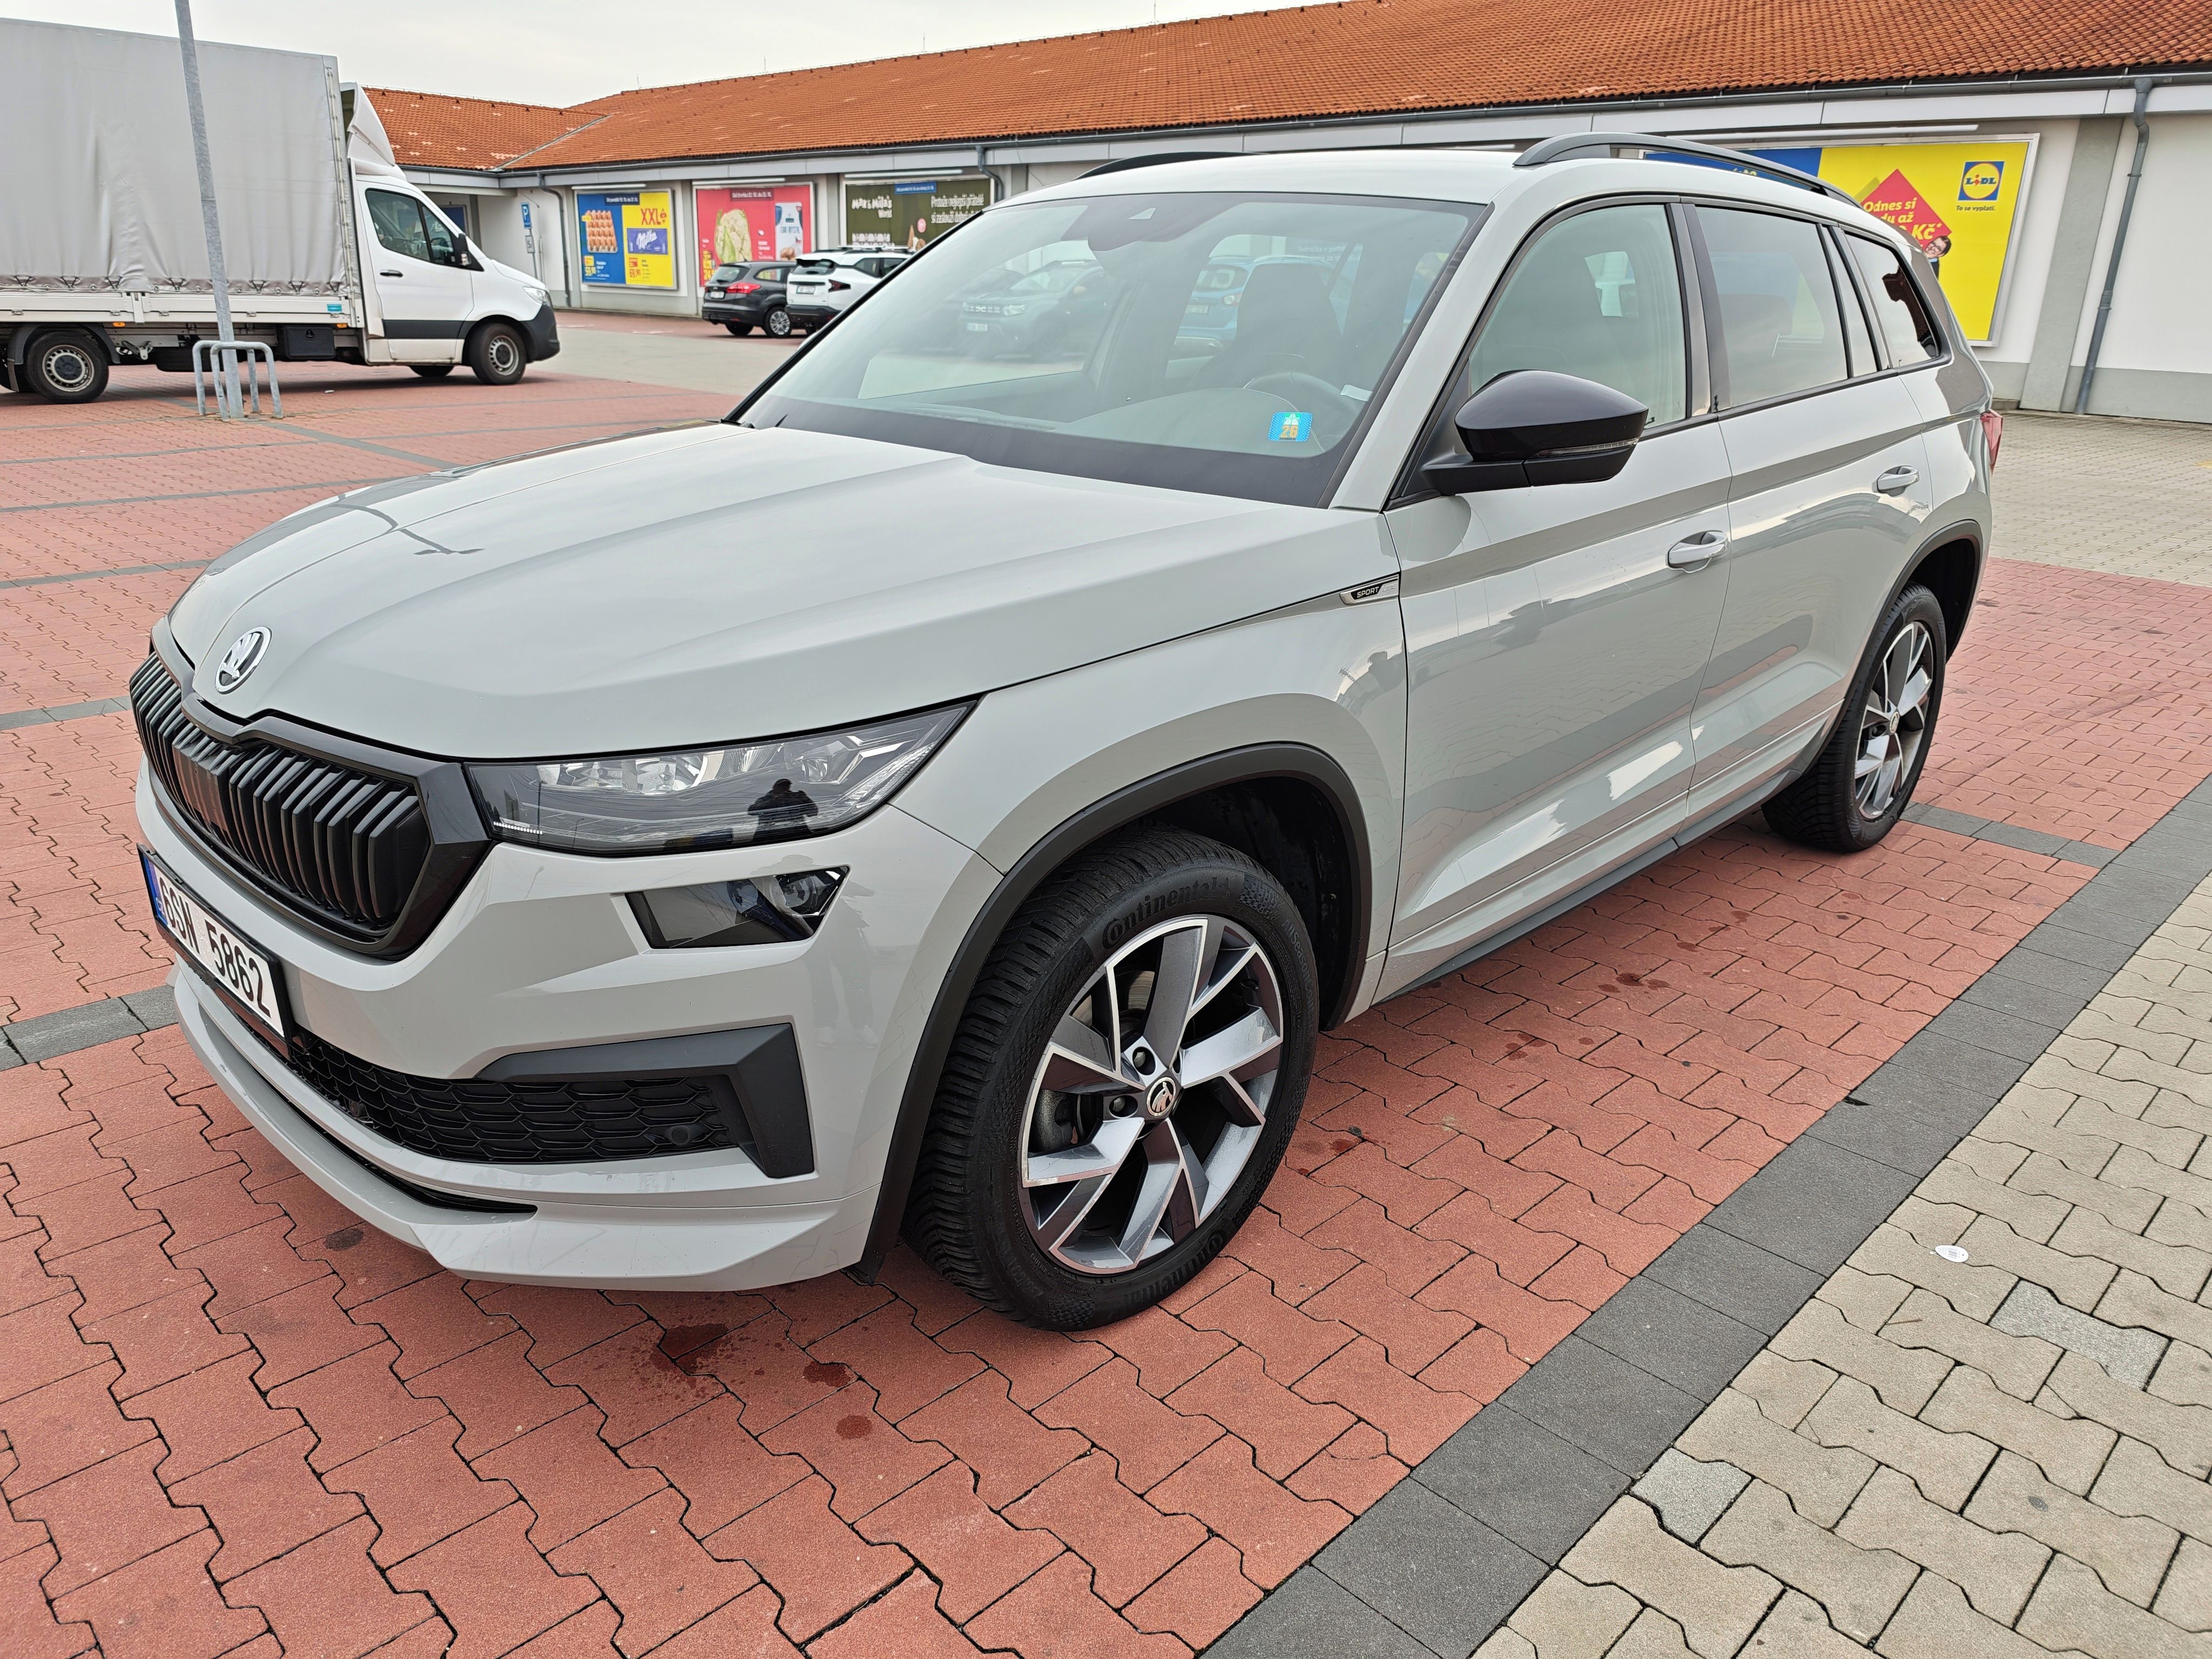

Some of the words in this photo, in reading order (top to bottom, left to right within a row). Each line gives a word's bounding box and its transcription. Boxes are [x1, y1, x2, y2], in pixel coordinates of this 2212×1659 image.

[1864, 200, 1902, 212] Odnes
[1904, 197, 1917, 210] si
[1898, 212, 1914, 223] až
[1279, 424, 1298, 438] 26
[1357, 586, 1379, 598] SPORT
[156, 897, 166, 916] CZ
[1102, 876, 1218, 950] Continental
[160, 877, 200, 955] 6SN
[204, 919, 272, 1019] 5862
